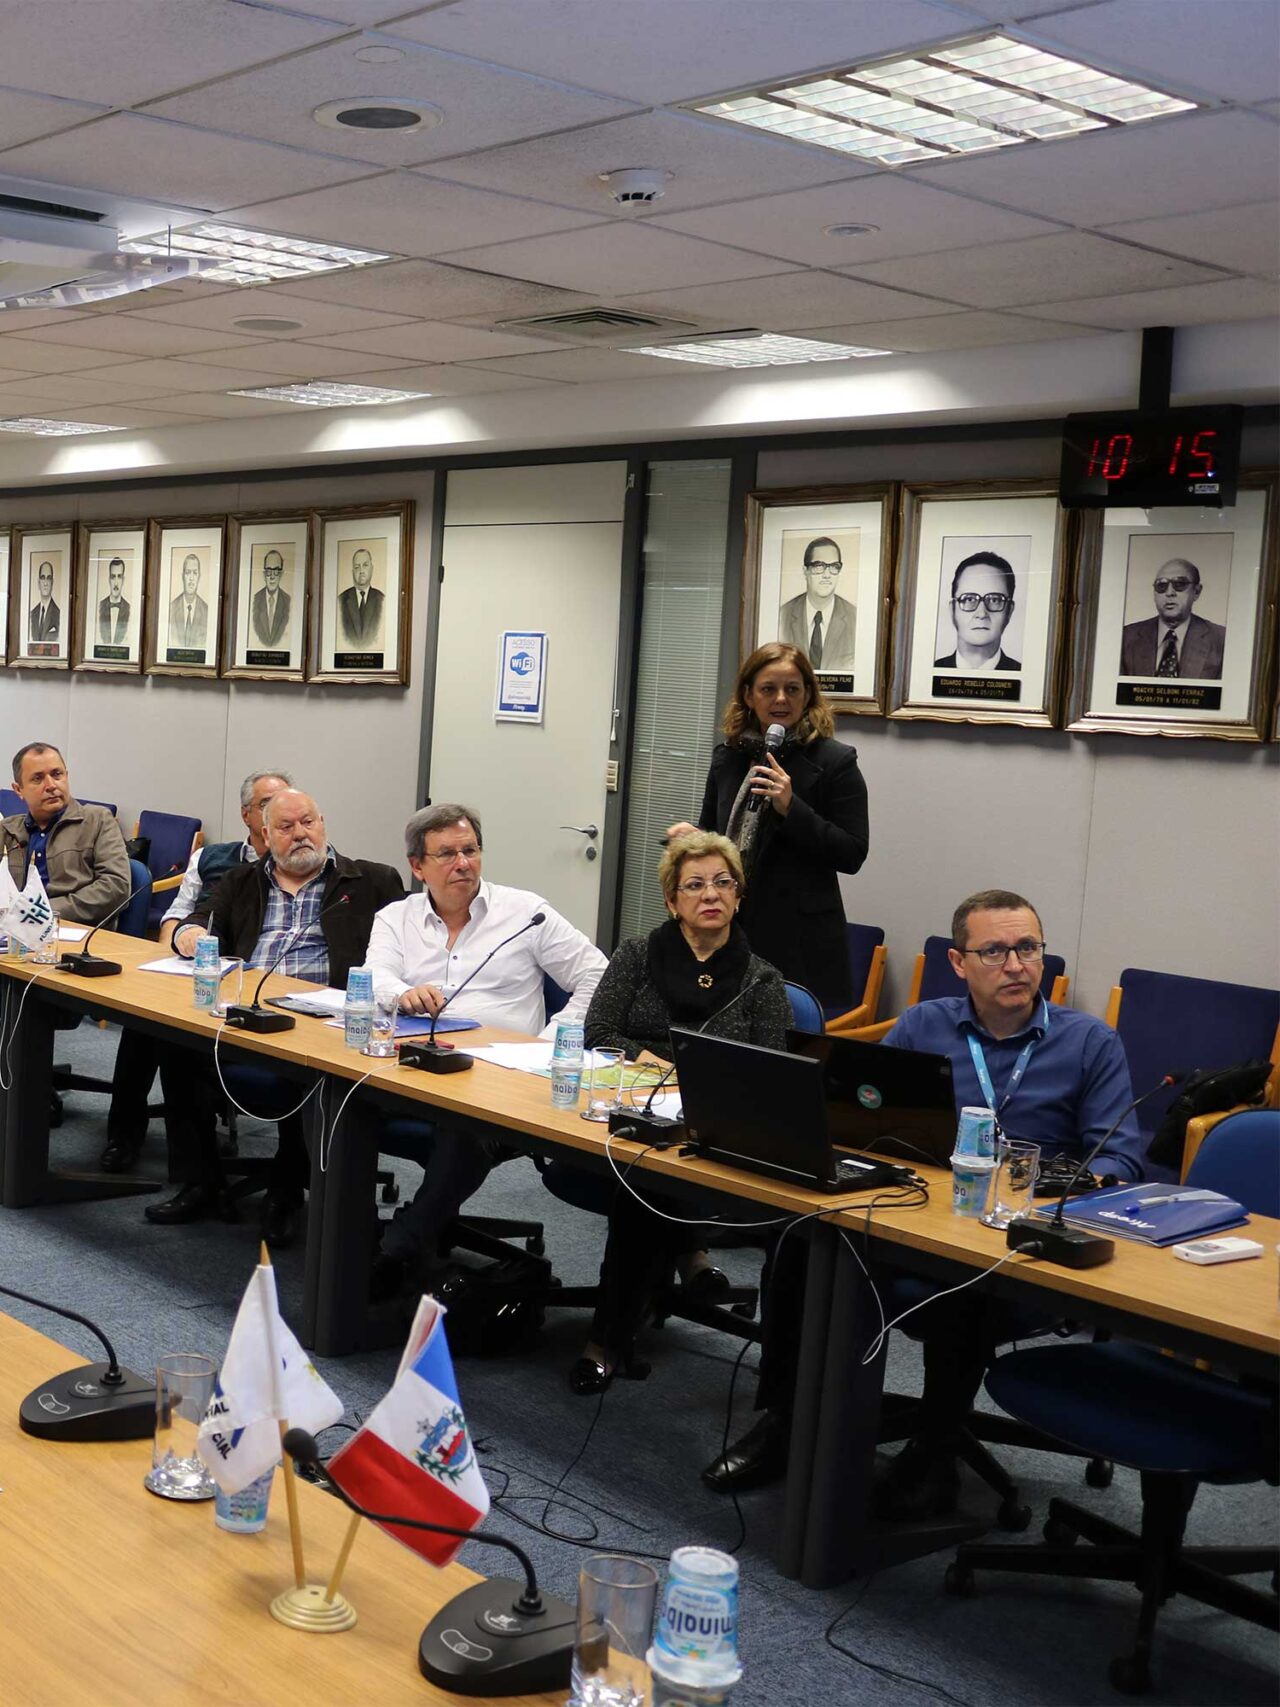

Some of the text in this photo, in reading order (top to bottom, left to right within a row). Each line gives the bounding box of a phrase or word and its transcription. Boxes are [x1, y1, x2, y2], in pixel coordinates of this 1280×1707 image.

[1087, 431, 1217, 480] 10 15
[1182, 688, 1205, 696] FERRAZ
